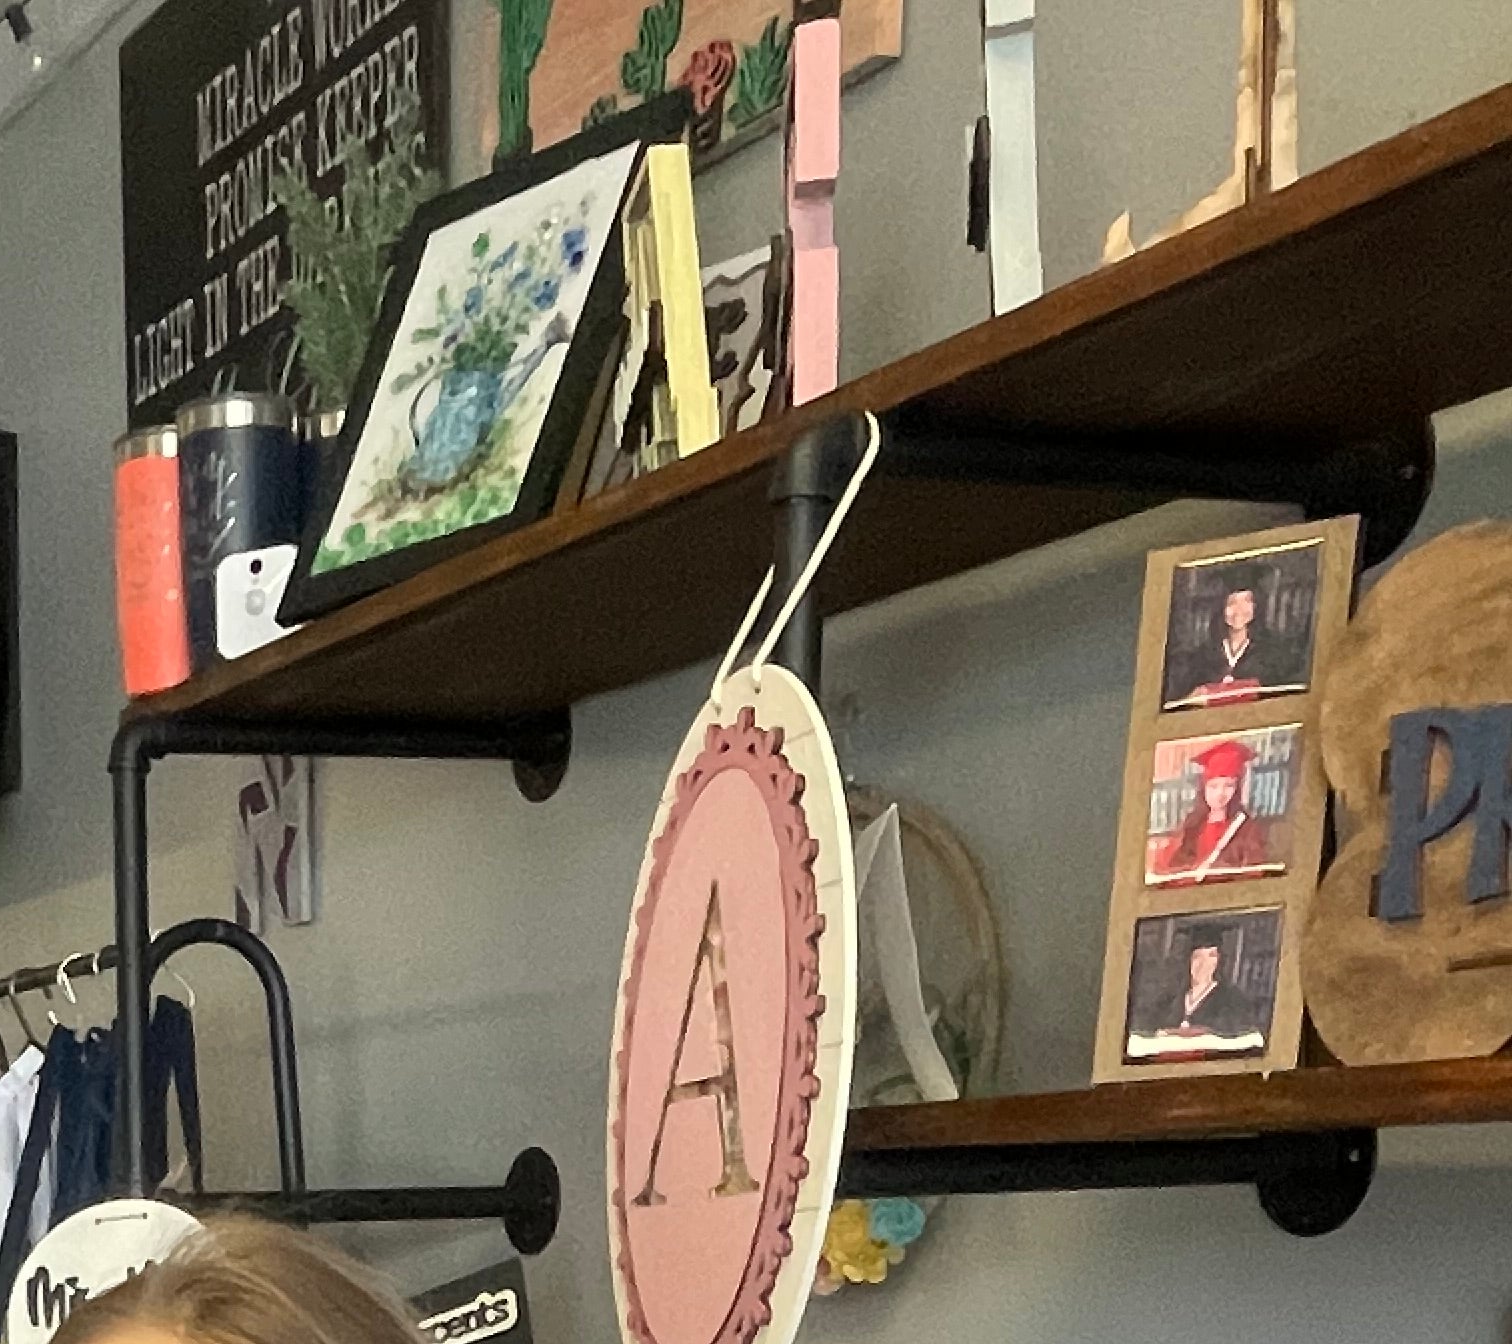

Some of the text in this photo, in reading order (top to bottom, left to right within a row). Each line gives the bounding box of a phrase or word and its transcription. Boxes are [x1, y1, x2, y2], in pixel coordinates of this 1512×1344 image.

[196, 7, 304, 167] MIRACLE
[134, 298, 194, 405] LIGHT
[203, 272, 229, 358] IN
[237, 234, 282, 336] THE
[631, 880, 760, 1206] A
